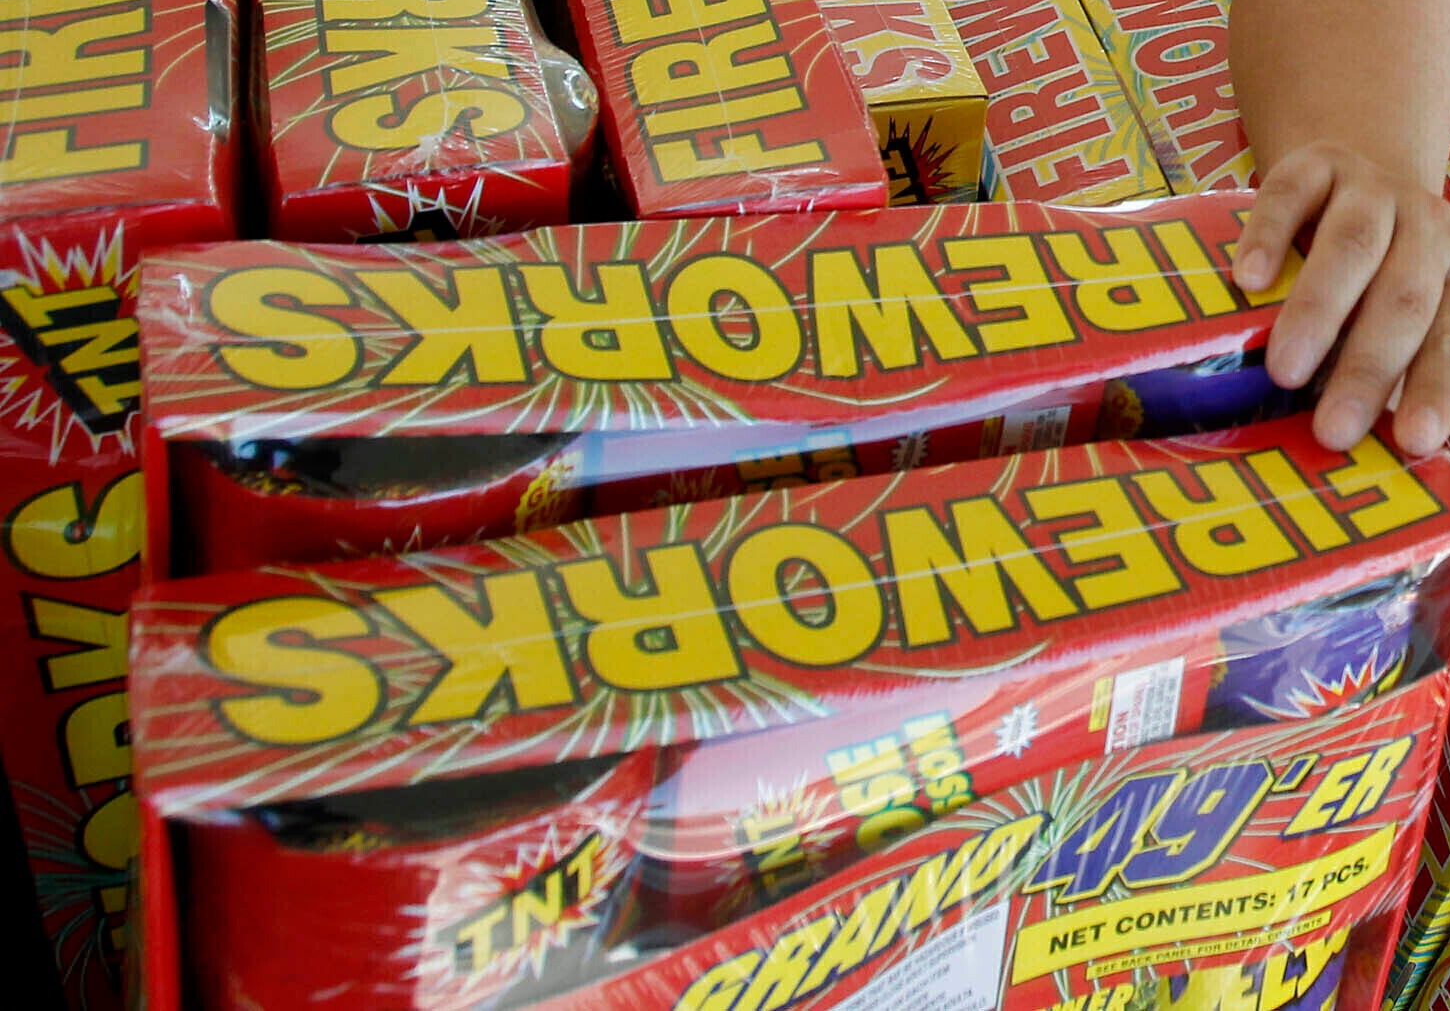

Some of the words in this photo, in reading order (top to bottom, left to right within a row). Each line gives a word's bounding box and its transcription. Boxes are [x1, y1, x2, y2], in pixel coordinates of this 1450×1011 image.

[202, 430, 1447, 748] FIREWORKS
[456, 834, 601, 974] TNT
[671, 811, 1049, 1011] GRAND
[1049, 922, 1106, 955] NET
[1114, 890, 1277, 935] CONTENTS:
[1288, 877, 1315, 904] 17
[1320, 856, 1371, 897] PCS.
